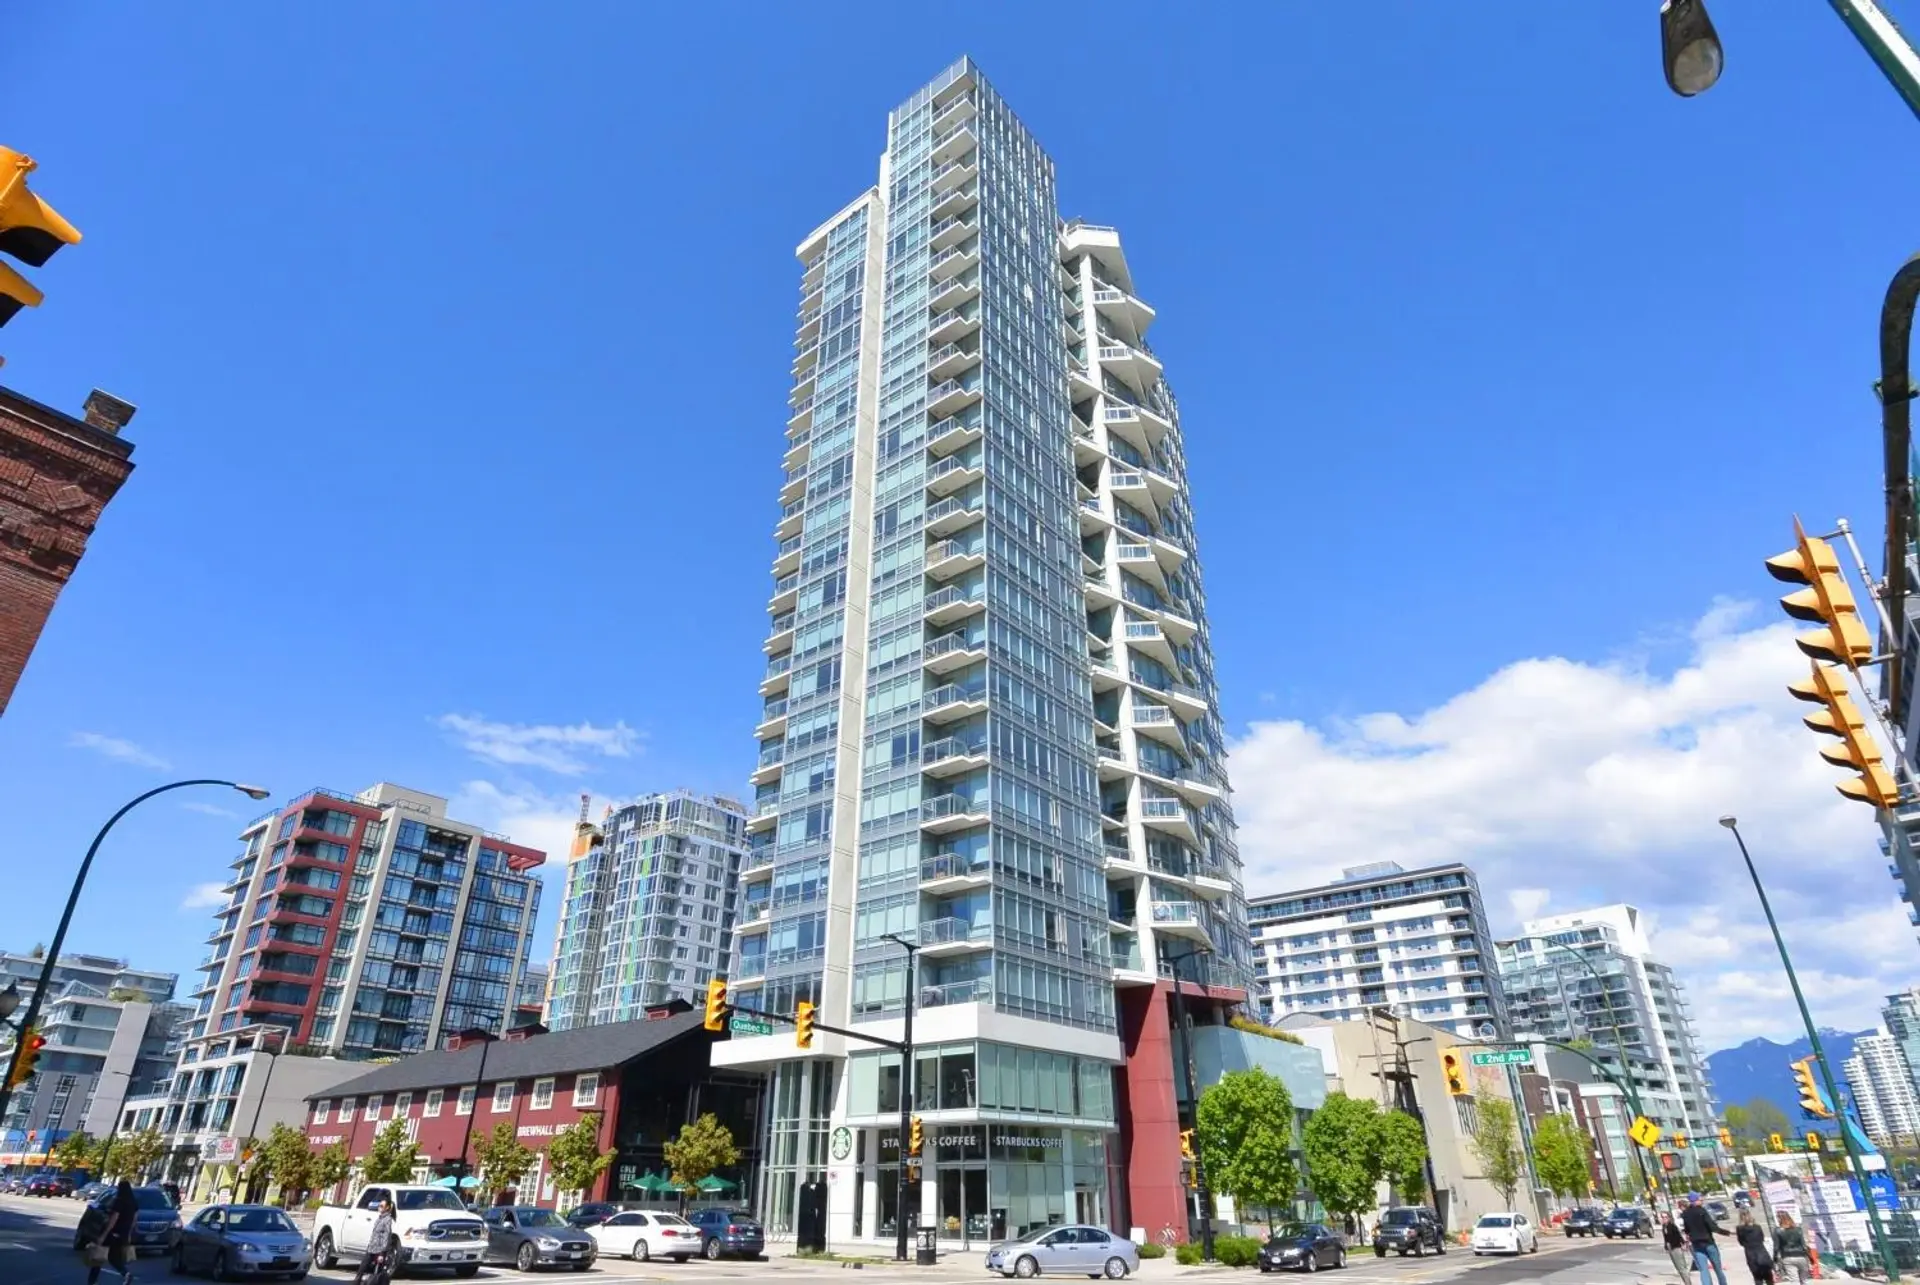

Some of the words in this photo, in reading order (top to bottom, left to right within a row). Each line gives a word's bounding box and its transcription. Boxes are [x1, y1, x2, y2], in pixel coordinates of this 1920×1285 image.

[1476, 1055, 1484, 1064] E
[1487, 1054, 1505, 1063] 2nd
[1508, 1053, 1526, 1062] Ave
[939, 1135, 976, 1147] COFFEE
[996, 1136, 1040, 1147] STARBUCKS
